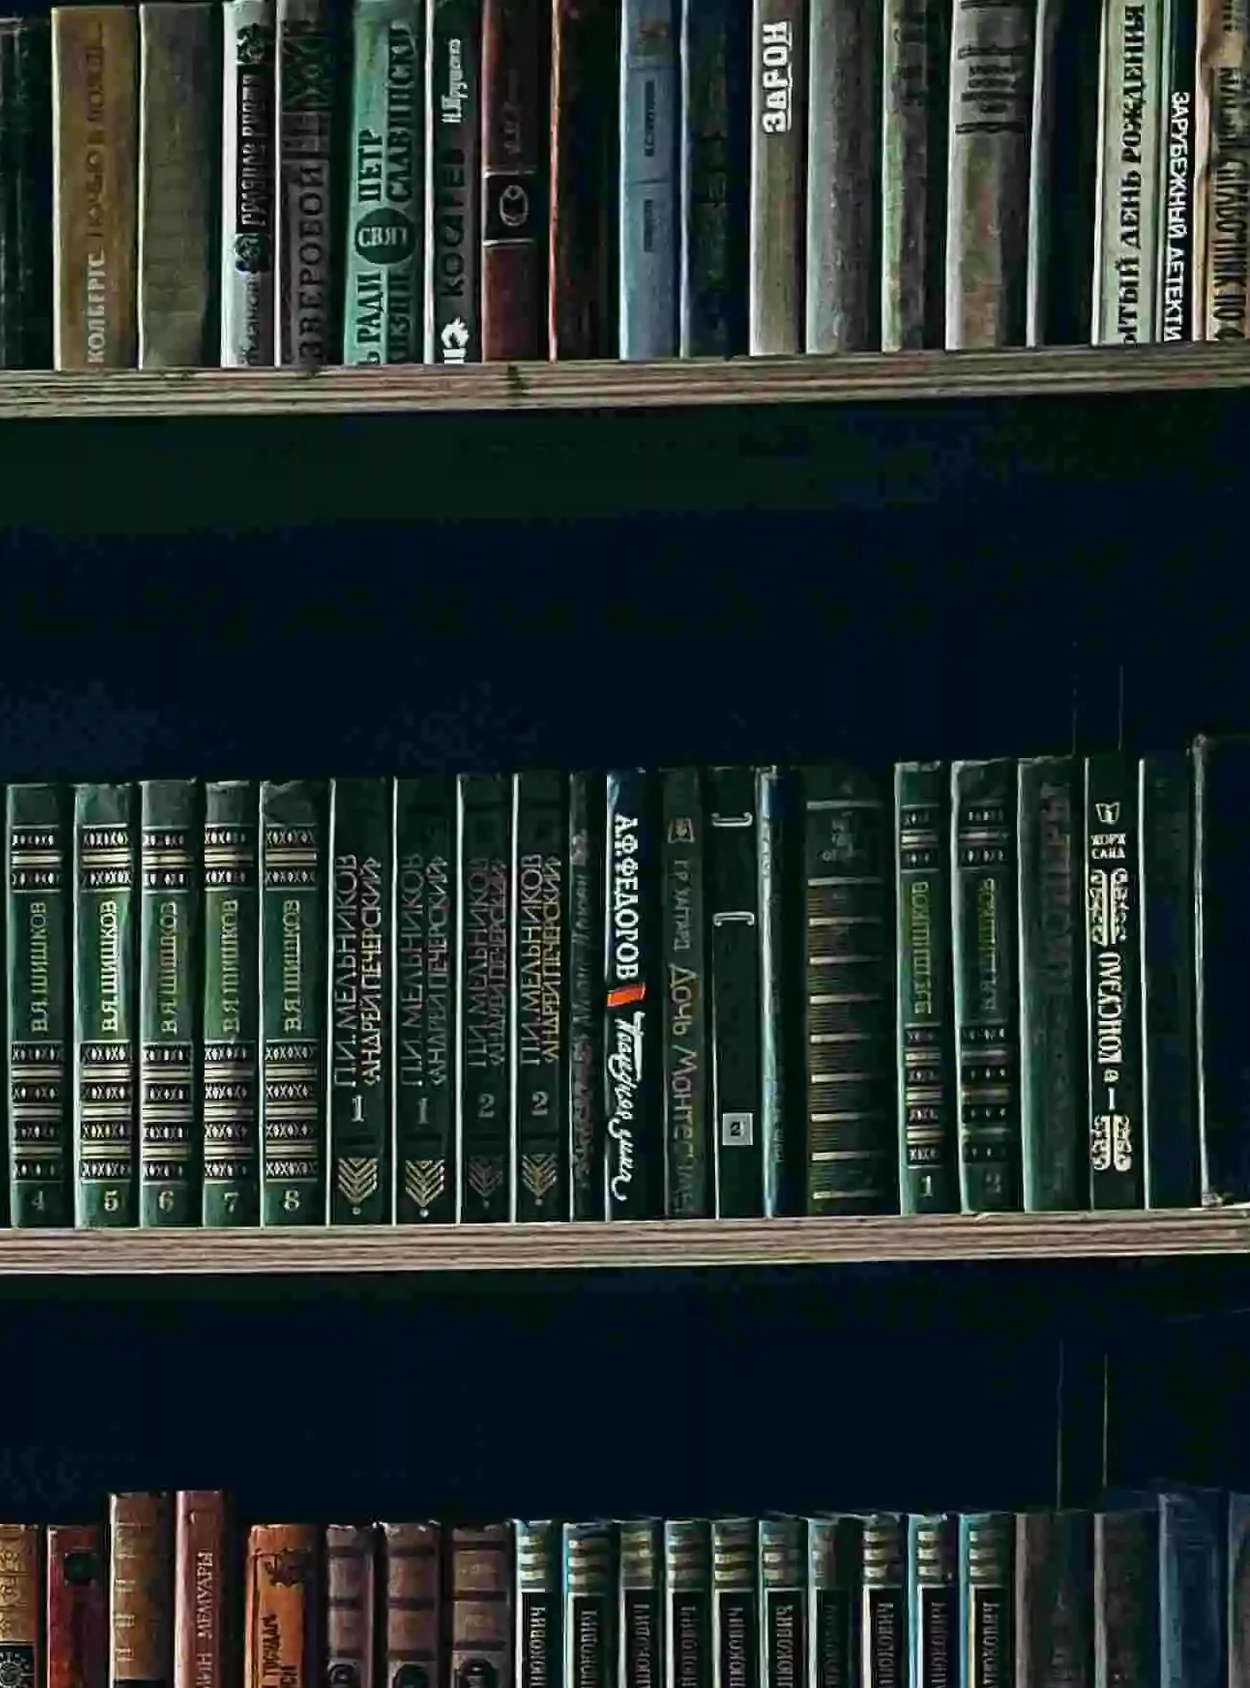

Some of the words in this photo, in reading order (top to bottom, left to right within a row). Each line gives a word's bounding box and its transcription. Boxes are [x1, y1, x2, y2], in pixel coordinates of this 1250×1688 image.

[1121, 4, 1145, 162] РОЖДЕНИЯ
[357, 128, 382, 203] ПЕТР
[439, 148, 464, 297] КОСАРЕВ
[1119, 171, 1142, 249] ДЕНЬ
[1168, 91, 1191, 239] ЗАРУБЕЖНЫЙ
[298, 166, 324, 361] ЗВЕРОБОЙ
[356, 273, 383, 343] РАДИ
[100, 900, 118, 993] ШИШКОВ
[335, 855, 358, 1029] МЕЛЬНИКОВ
[521, 854, 543, 1011] МЕЛЬНИКОВ
[1096, 952, 1123, 1065] КОНСУЭЛО
[195, 1553, 214, 1638] МЕМУАРЫ
